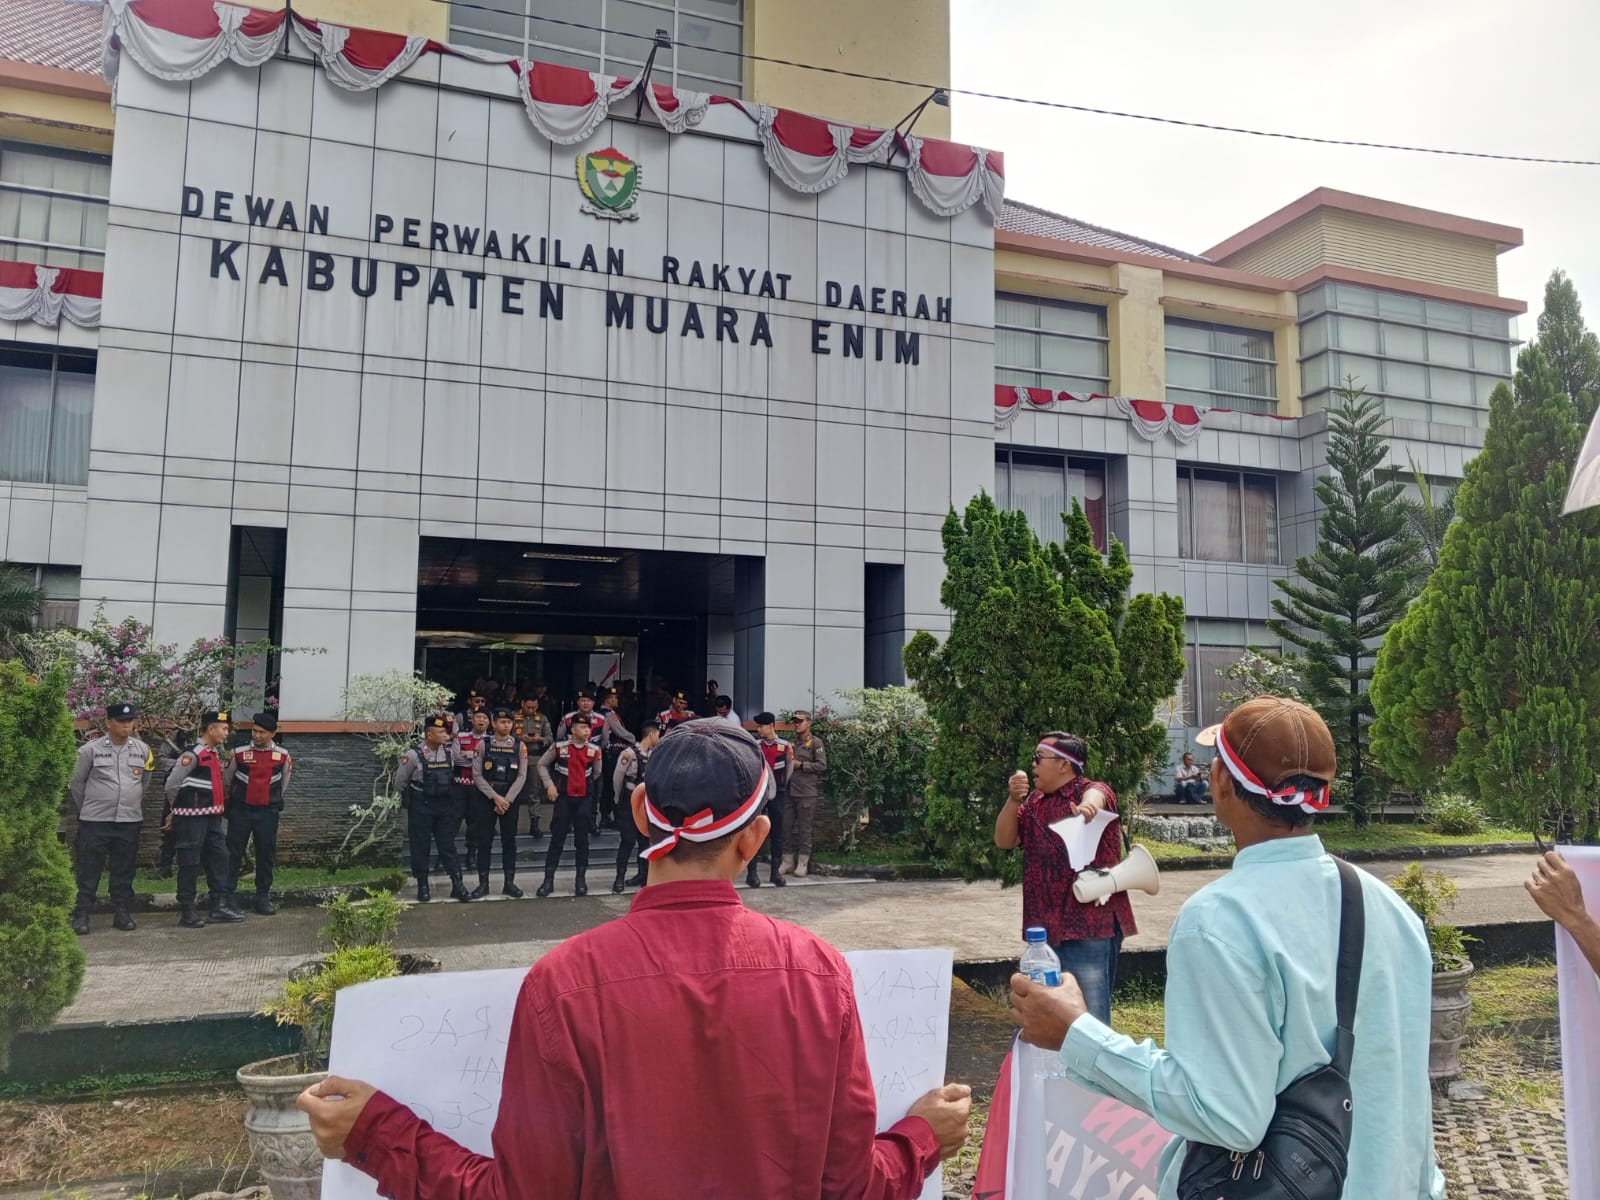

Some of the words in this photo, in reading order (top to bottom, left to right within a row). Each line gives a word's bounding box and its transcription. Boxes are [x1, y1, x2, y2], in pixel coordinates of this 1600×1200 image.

[182, 185, 331, 237] DEWAN
[374, 213, 627, 278] PERWAKILAN
[662, 254, 792, 302] RAKYAT
[825, 279, 954, 325] DAERAH
[210, 238, 566, 321] KABUPATEN
[605, 289, 774, 349] MUARA
[812, 318, 922, 367] ENIM
